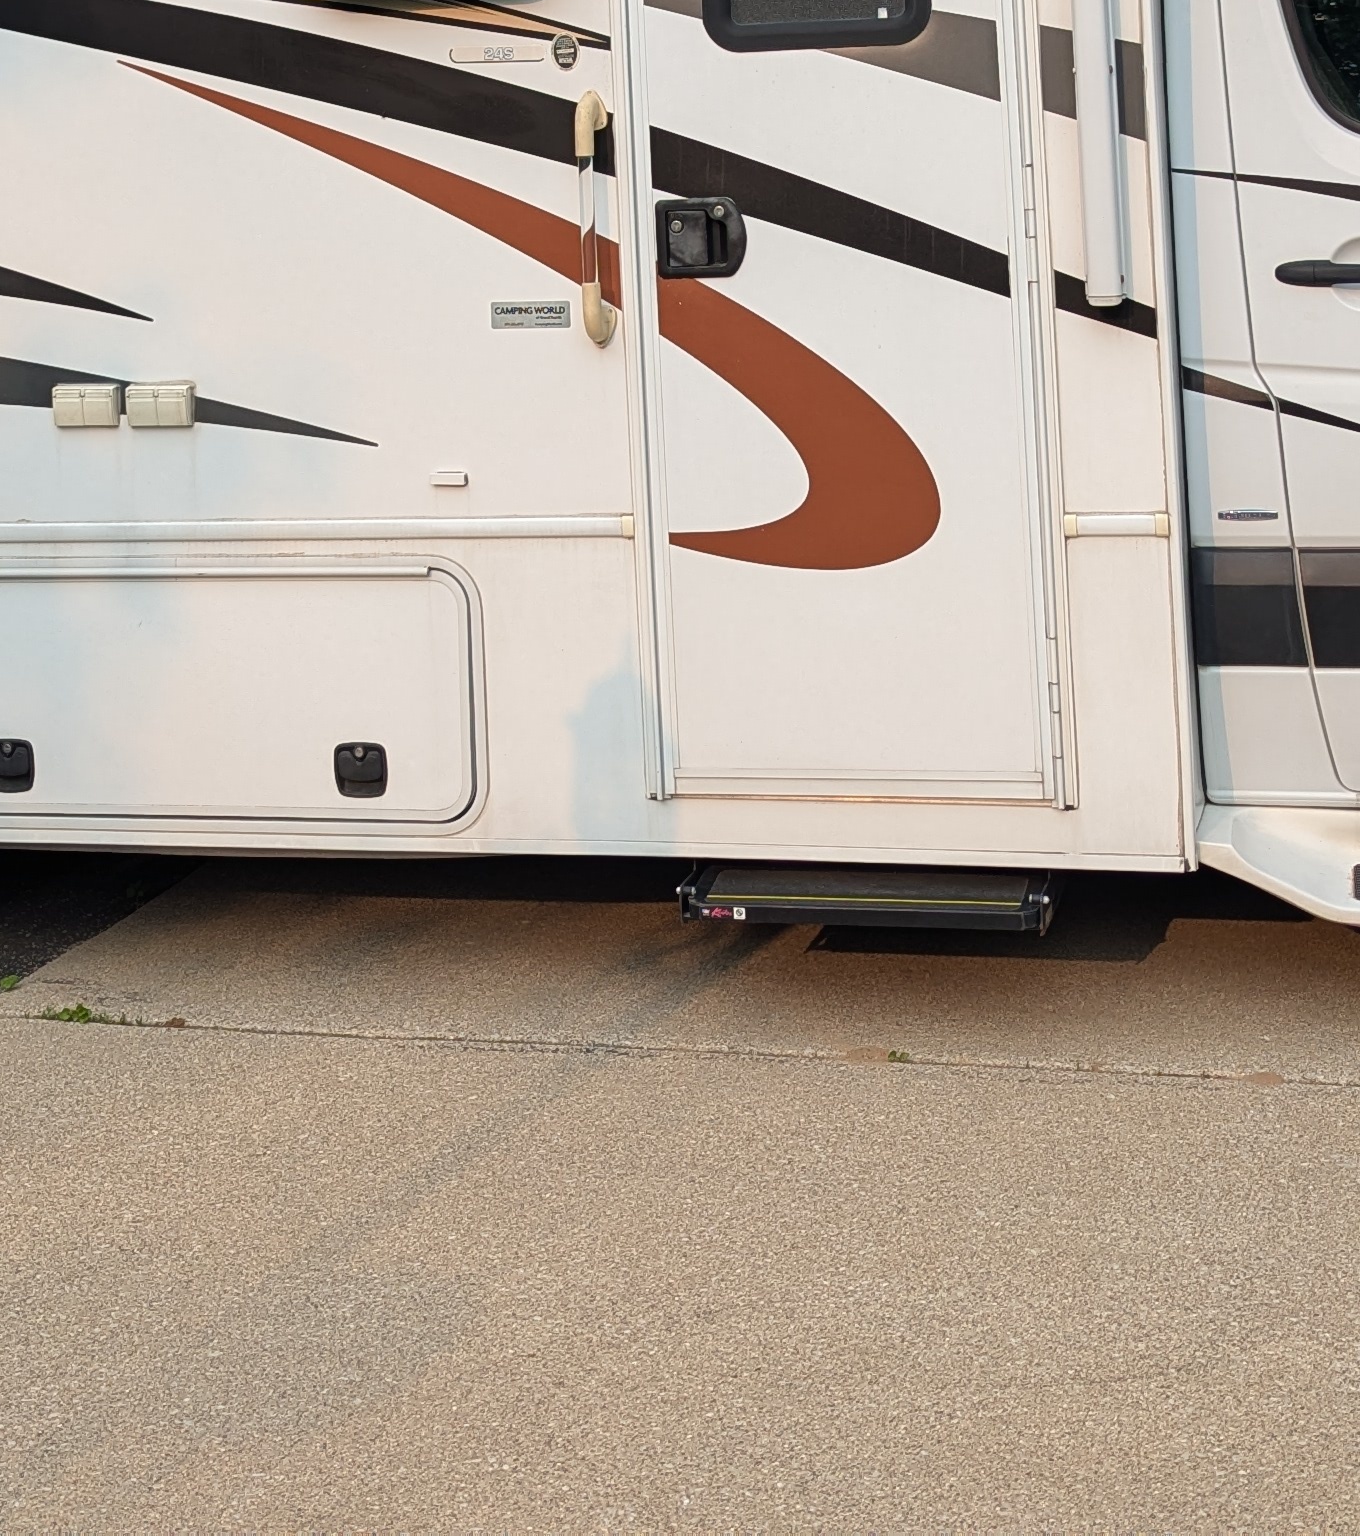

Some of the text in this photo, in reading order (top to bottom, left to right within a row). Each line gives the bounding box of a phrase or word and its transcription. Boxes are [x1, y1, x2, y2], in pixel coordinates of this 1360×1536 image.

[483, 46, 515, 61] 24S
[494, 305, 566, 316] CAMPING WORLD
